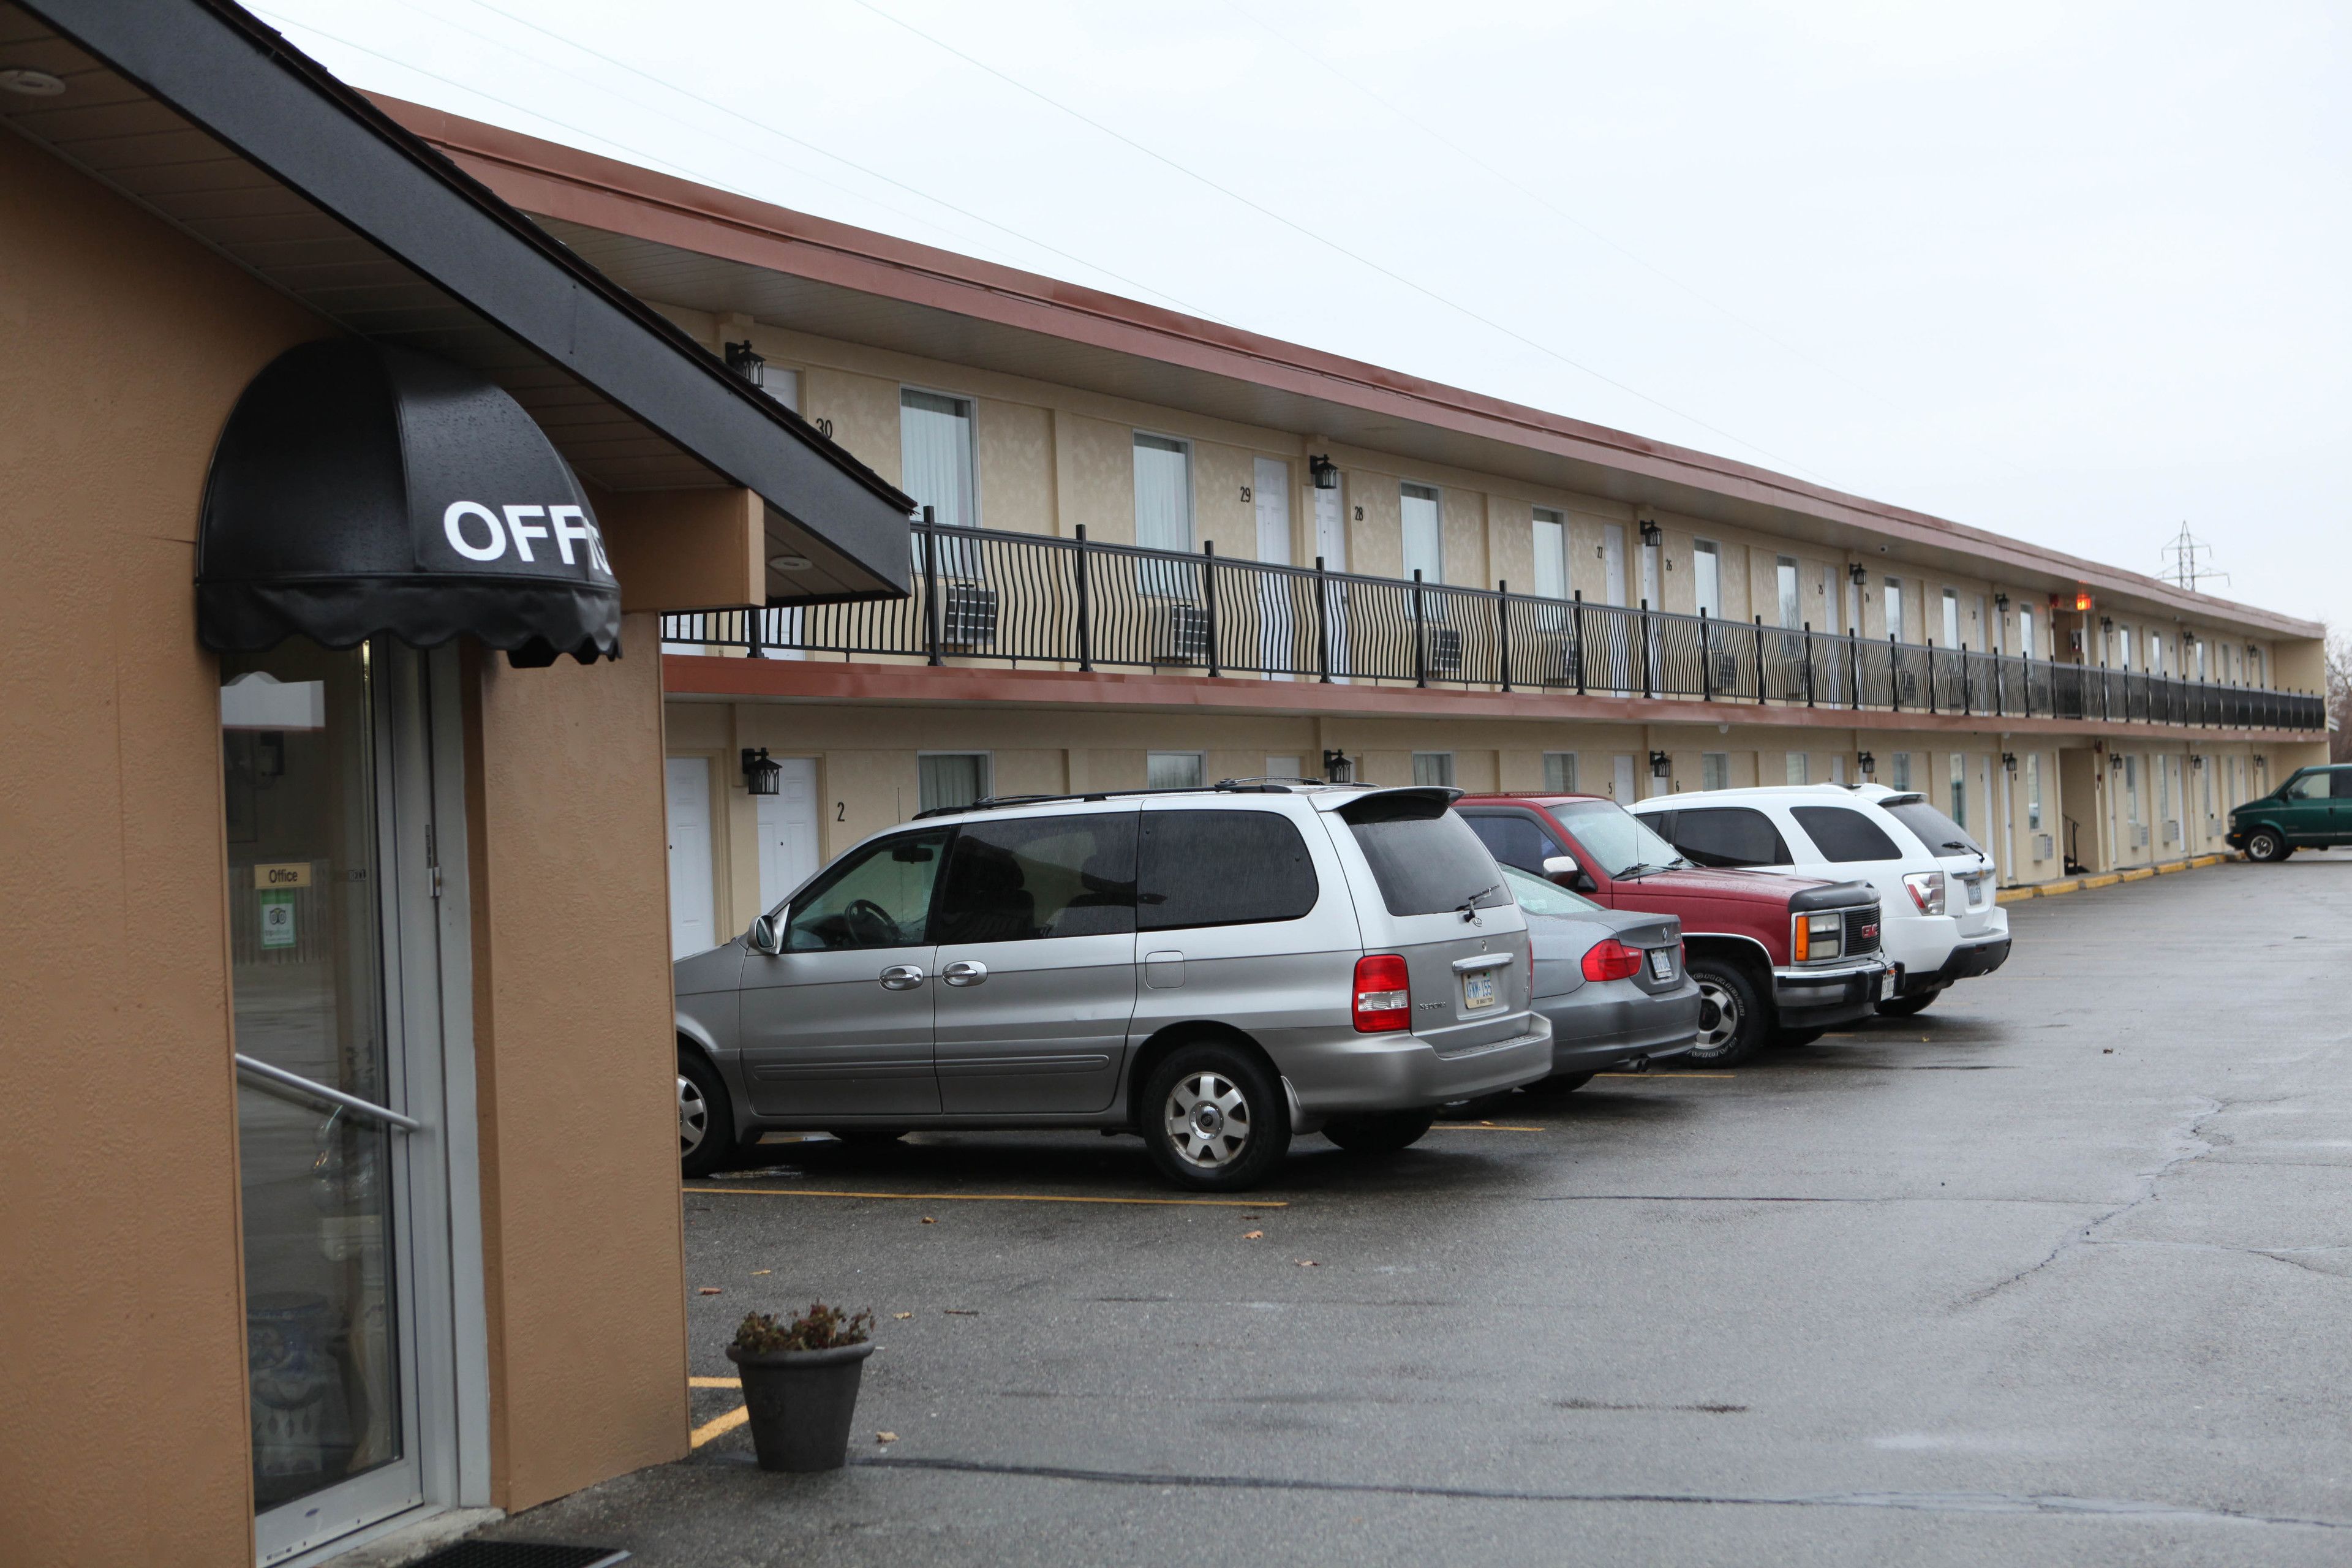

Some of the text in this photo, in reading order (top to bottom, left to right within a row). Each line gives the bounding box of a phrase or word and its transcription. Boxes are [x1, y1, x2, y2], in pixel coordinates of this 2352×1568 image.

[815, 418, 833, 439] 30
[1240, 486, 1251, 503] 29
[1354, 506, 1364, 521] 28
[443, 500, 612, 576] OFFIC
[1596, 546, 1604, 559] 27
[1666, 559, 1673, 571] 26
[1608, 782, 1613, 794] 5
[1676, 781, 1680, 792] 6
[837, 801, 845, 822] 2
[269, 869, 298, 884] Office
[1481, 979, 1493, 997] 155
